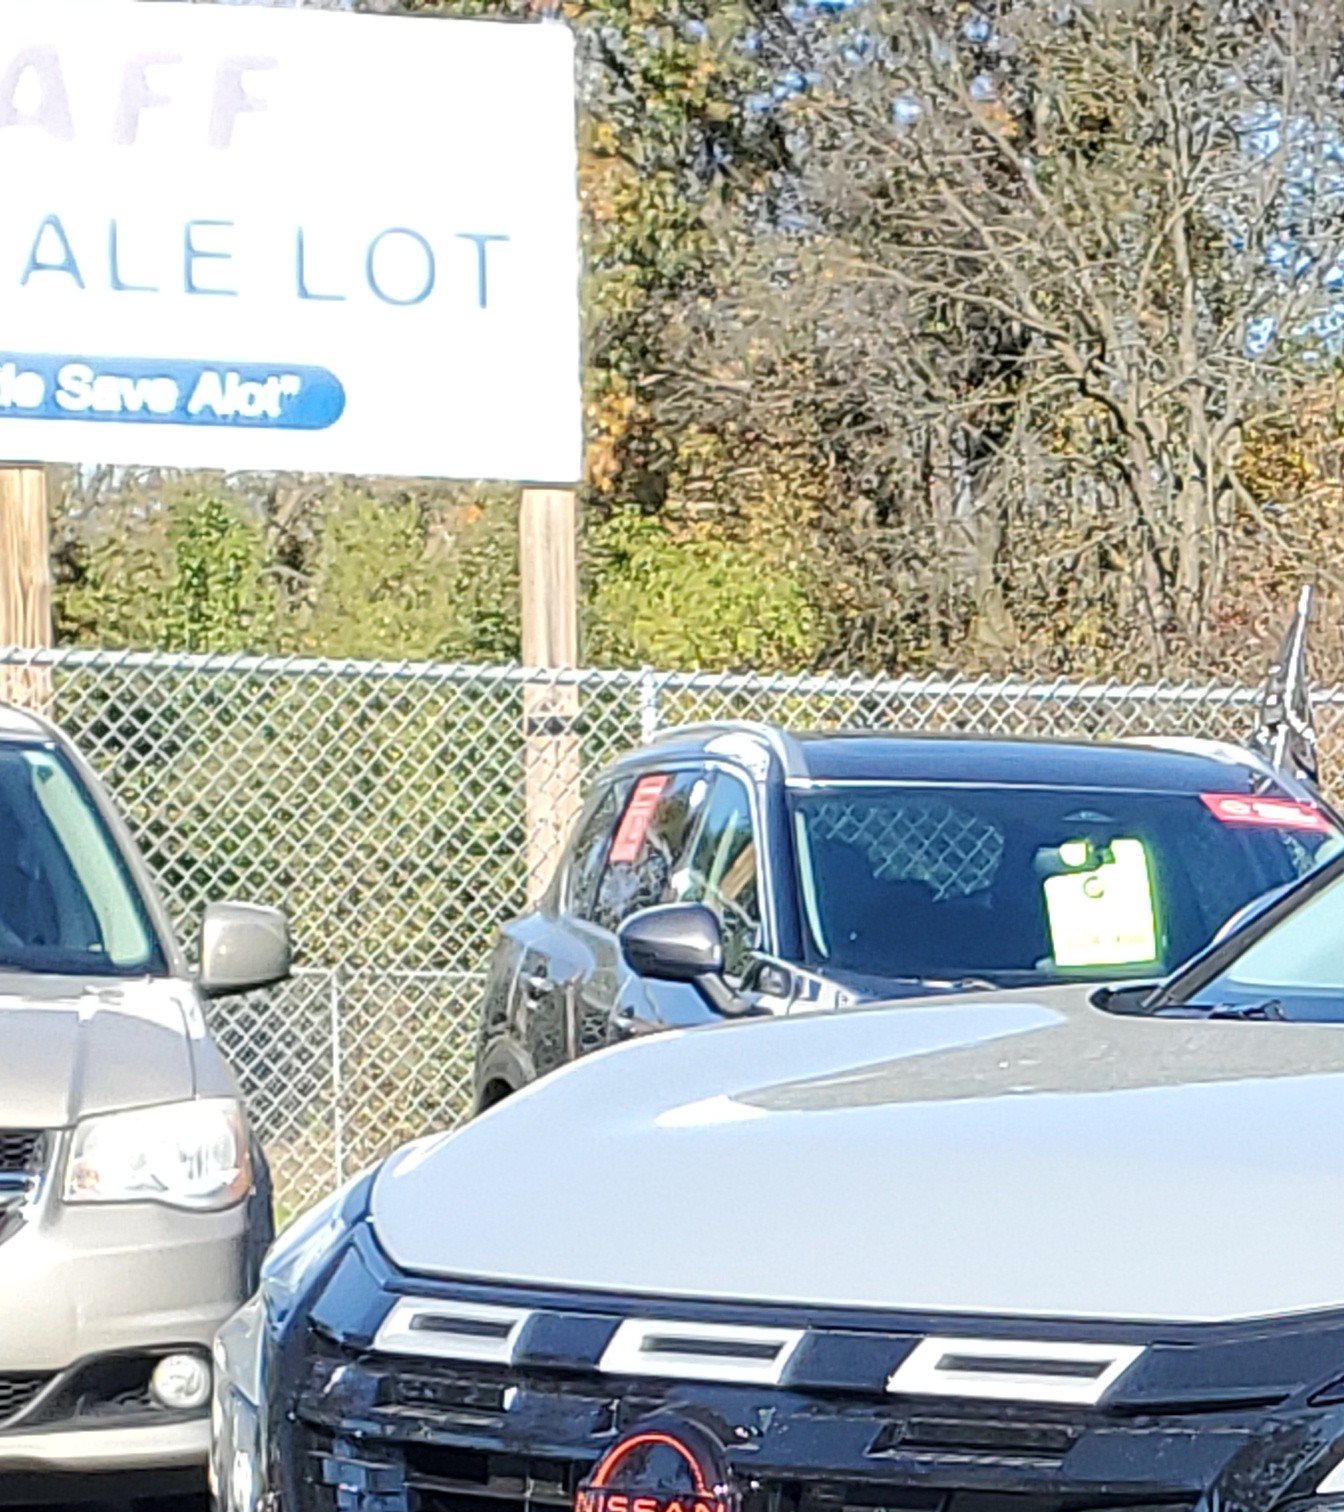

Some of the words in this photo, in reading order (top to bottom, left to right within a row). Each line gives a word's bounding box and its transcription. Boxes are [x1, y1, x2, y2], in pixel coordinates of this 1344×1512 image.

[20, 212, 239, 297] ALE
[296, 226, 511, 309] LOT
[55, 363, 180, 414] Save
